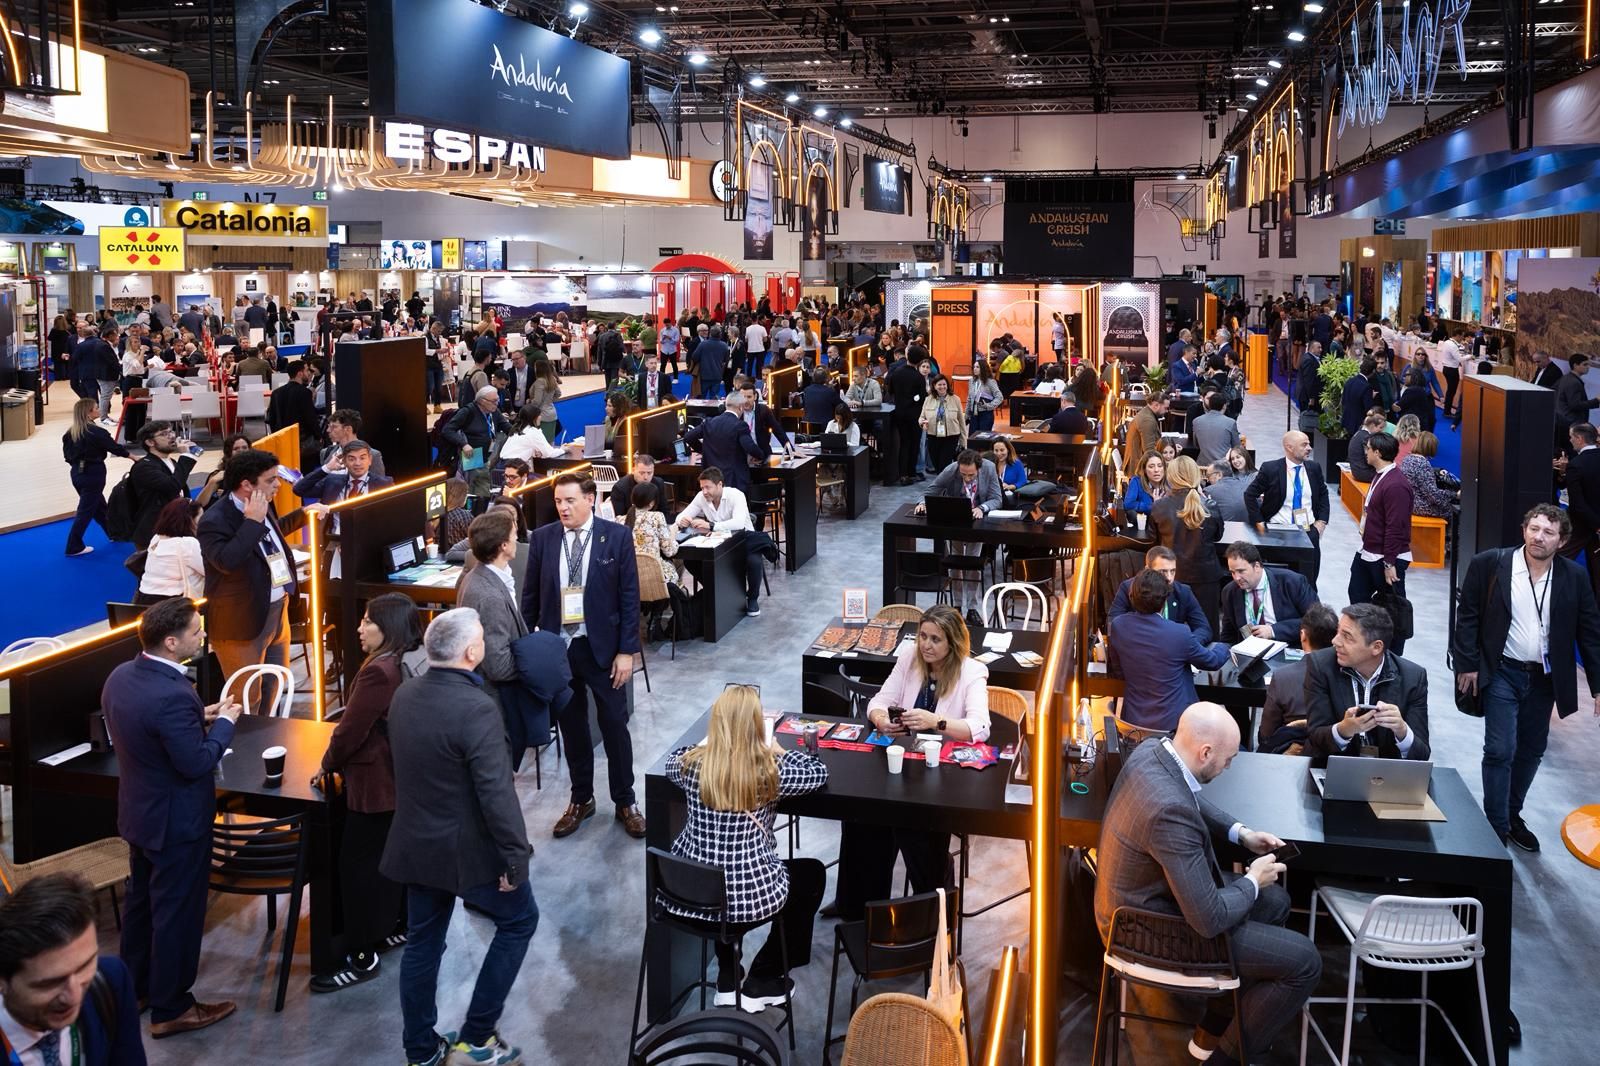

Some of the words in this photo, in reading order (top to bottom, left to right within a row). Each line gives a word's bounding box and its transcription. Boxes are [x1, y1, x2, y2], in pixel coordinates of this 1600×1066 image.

[489, 43, 574, 103] Andalucía
[176, 206, 311, 233] Catalonia
[1029, 213, 1109, 224] ANDALUSIAN
[1047, 225, 1089, 235] CRUSH
[107, 244, 179, 253] CATALUNYA
[937, 303, 970, 314] PRESS
